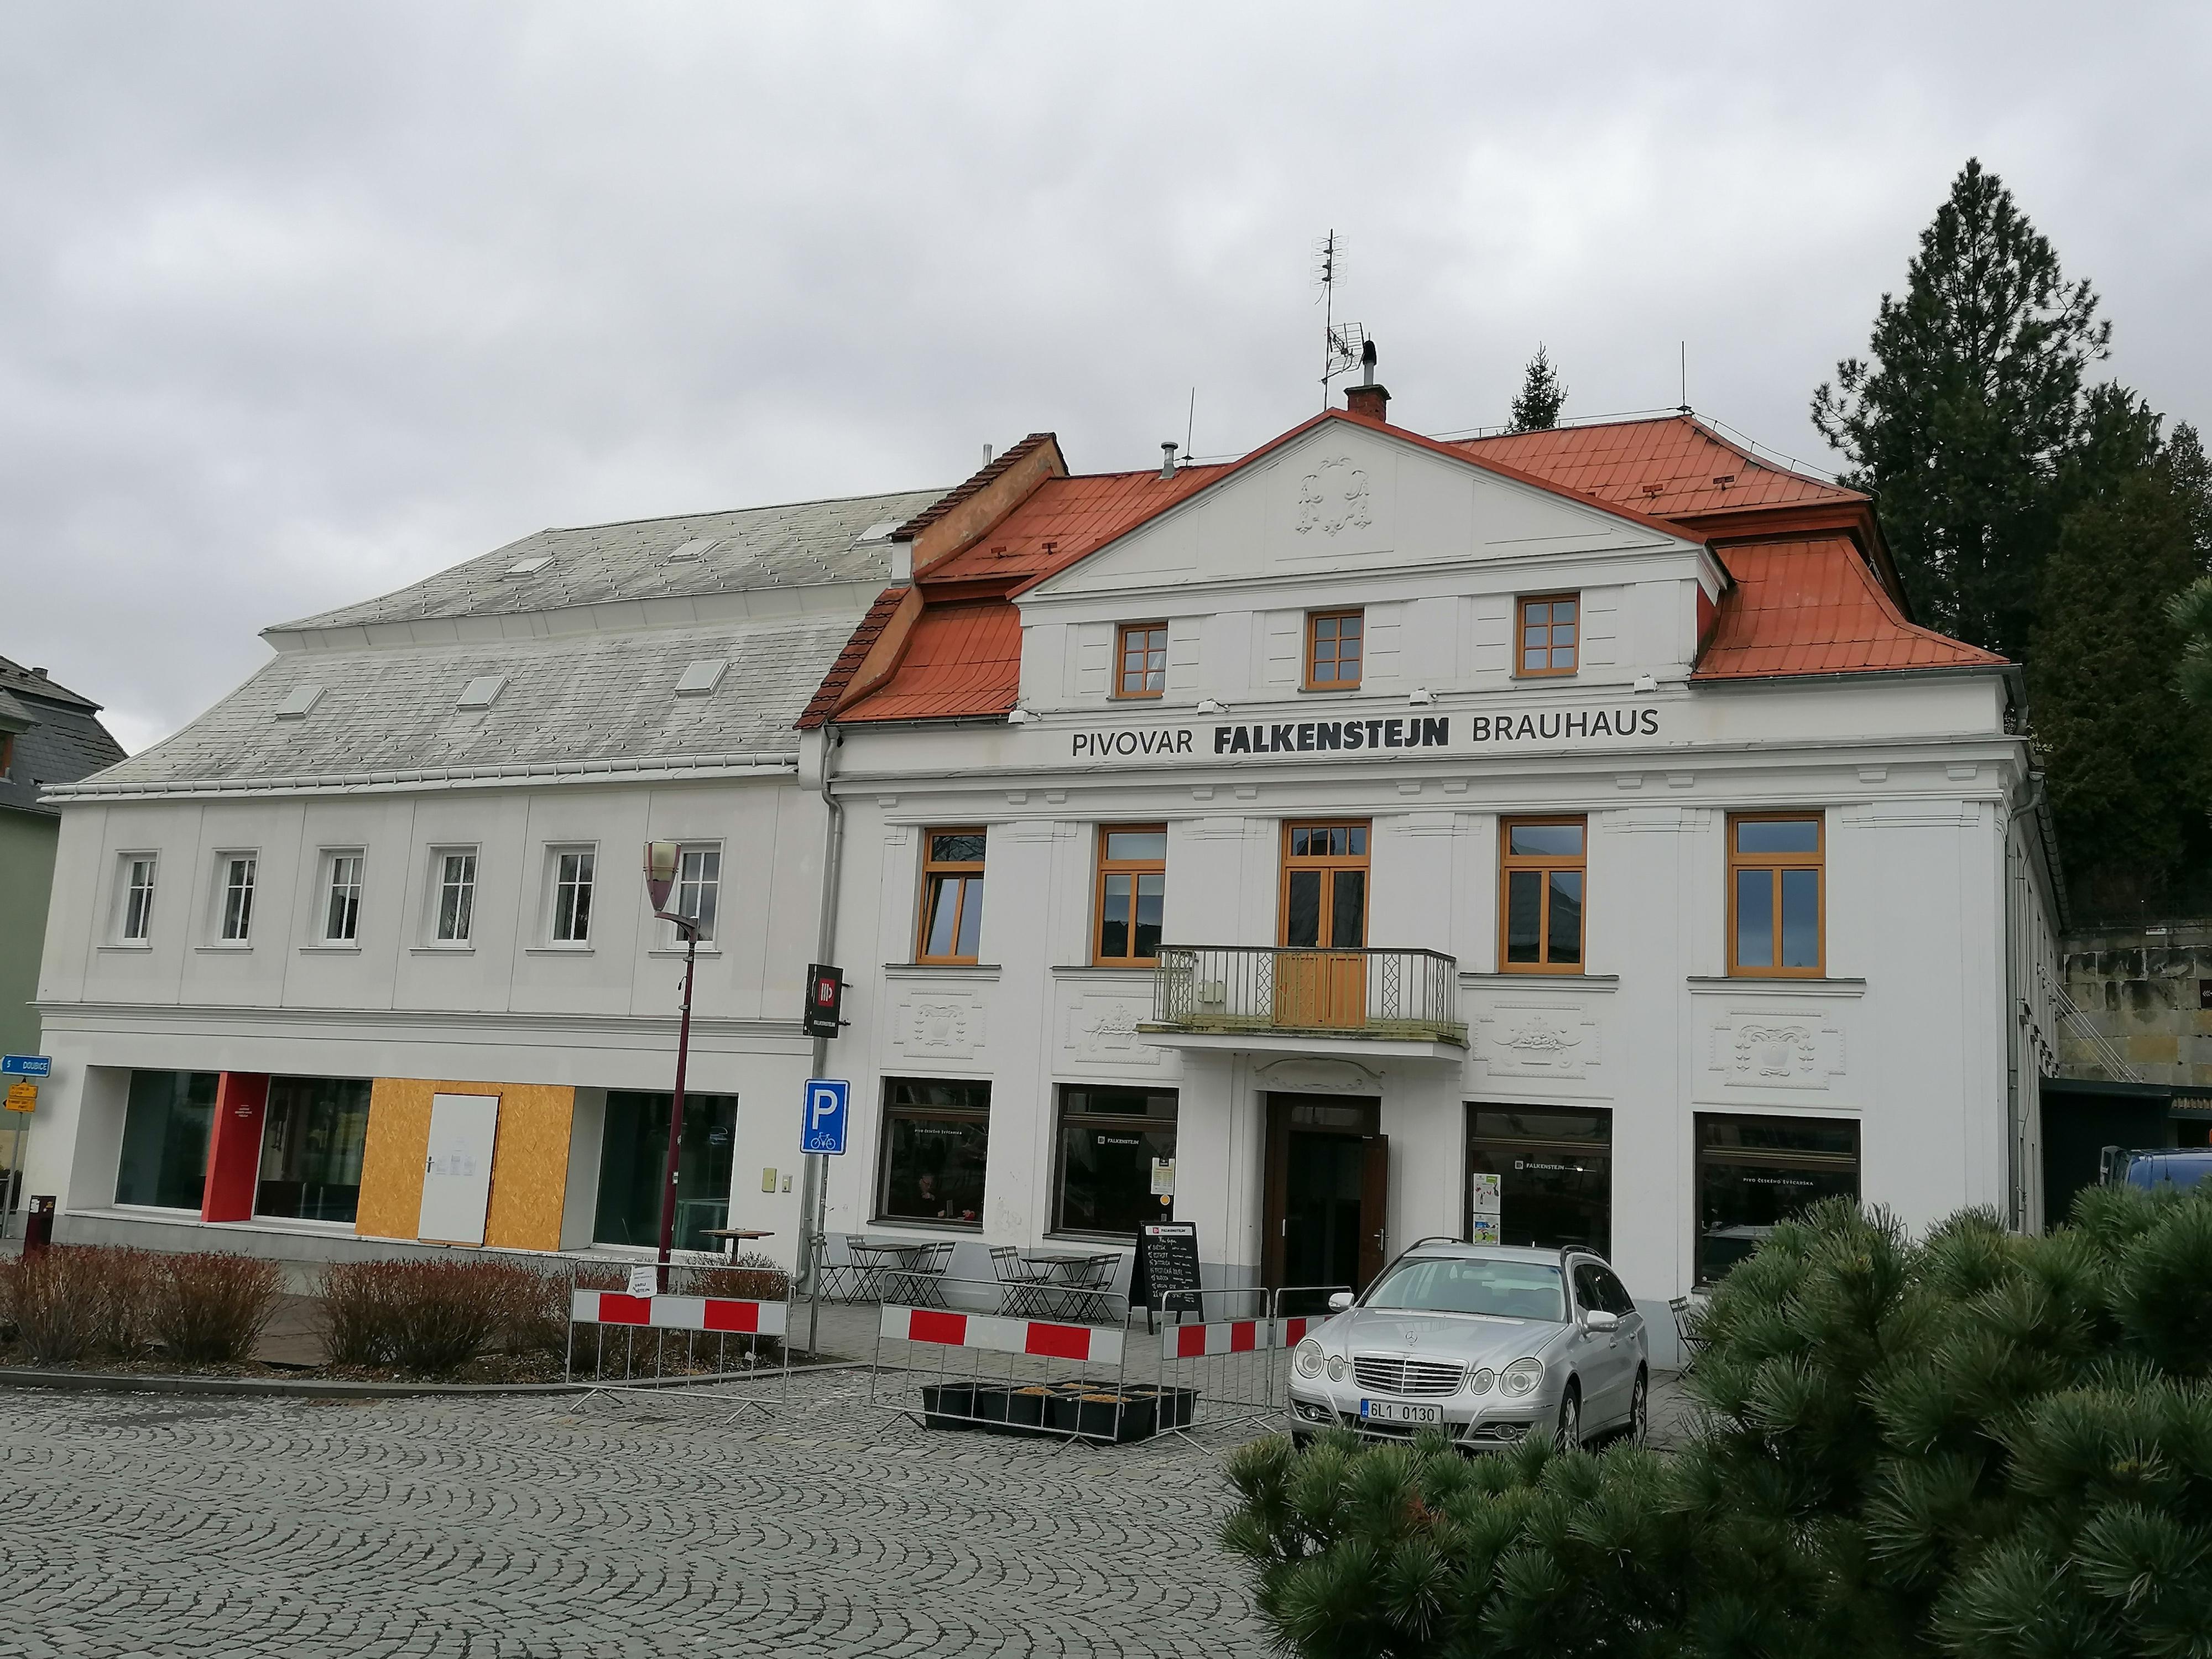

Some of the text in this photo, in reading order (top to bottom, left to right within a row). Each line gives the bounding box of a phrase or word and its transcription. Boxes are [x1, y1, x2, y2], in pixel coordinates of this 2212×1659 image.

[1072, 709, 1658, 757] PIVOVAR FALKENSTEJN BRAUHAUS
[23, 1061, 48, 1071] DOUBICE
[812, 1088, 838, 1130] P
[1371, 1404, 1434, 1422] 6L1 0130
